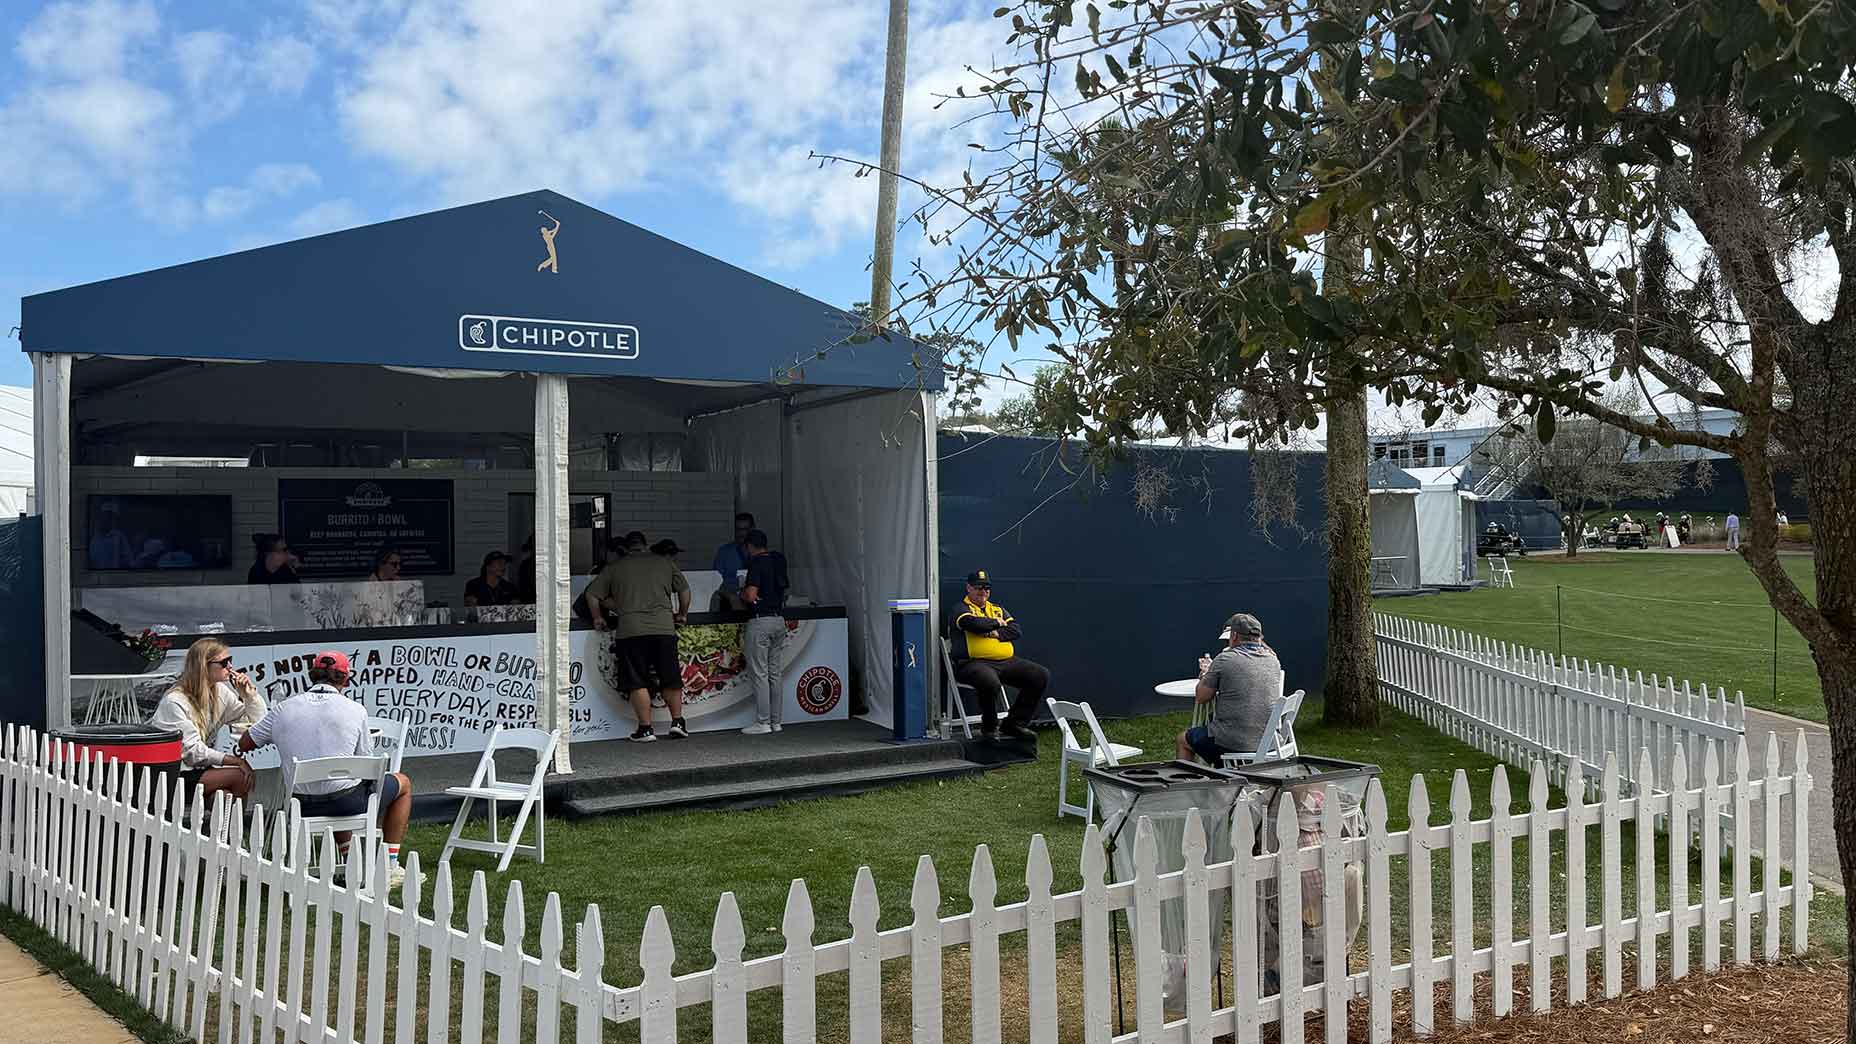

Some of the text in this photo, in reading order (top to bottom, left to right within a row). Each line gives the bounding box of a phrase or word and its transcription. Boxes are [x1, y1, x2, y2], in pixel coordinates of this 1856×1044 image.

[502, 326, 630, 350] CHIPOTLE
[327, 513, 409, 526] BURRITO BOWL
[274, 654, 316, 676] NOT
[367, 649, 381, 665] A
[391, 645, 458, 667] BOWL
[464, 654, 491, 671] OR
[495, 652, 583, 684] BURO
[348, 667, 424, 687] RAPPED,
[431, 669, 586, 701] HAND-CRAD
[799, 668, 840, 688] CHIPOTLE
[375, 687, 446, 708] EVERY
[448, 692, 491, 717] DAY,
[496, 703, 591, 722] RESPBLY
[431, 713, 455, 725] FOR
[458, 716, 480, 730] THE
